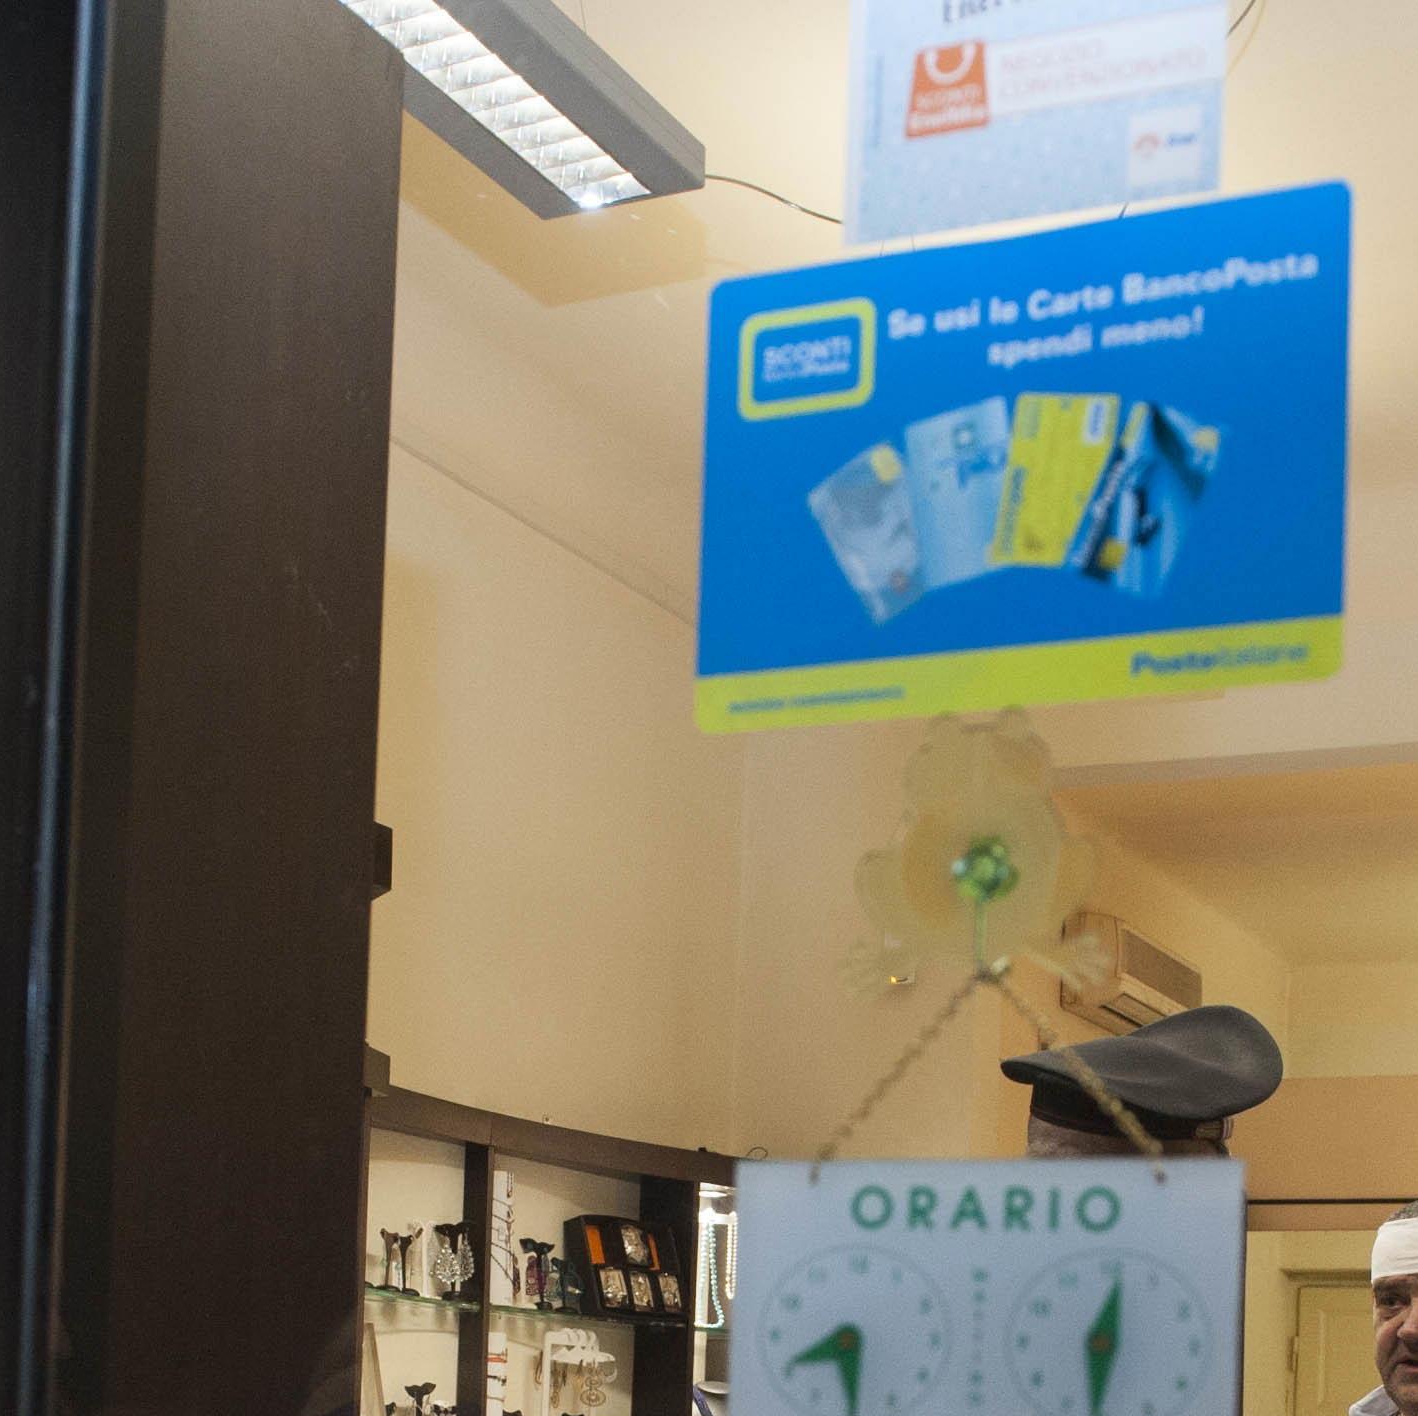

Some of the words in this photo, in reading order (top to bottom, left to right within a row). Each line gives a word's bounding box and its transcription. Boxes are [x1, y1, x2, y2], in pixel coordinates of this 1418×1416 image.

[887, 307, 926, 340] Se
[933, 297, 981, 333] usi
[987, 295, 1020, 325] le
[1027, 285, 1114, 321] Carte
[1122, 253, 1319, 305] BancoPosta
[987, 322, 1092, 369] spendi
[1101, 305, 1205, 348] meno!
[849, 1184, 1123, 1232] ORARIO
